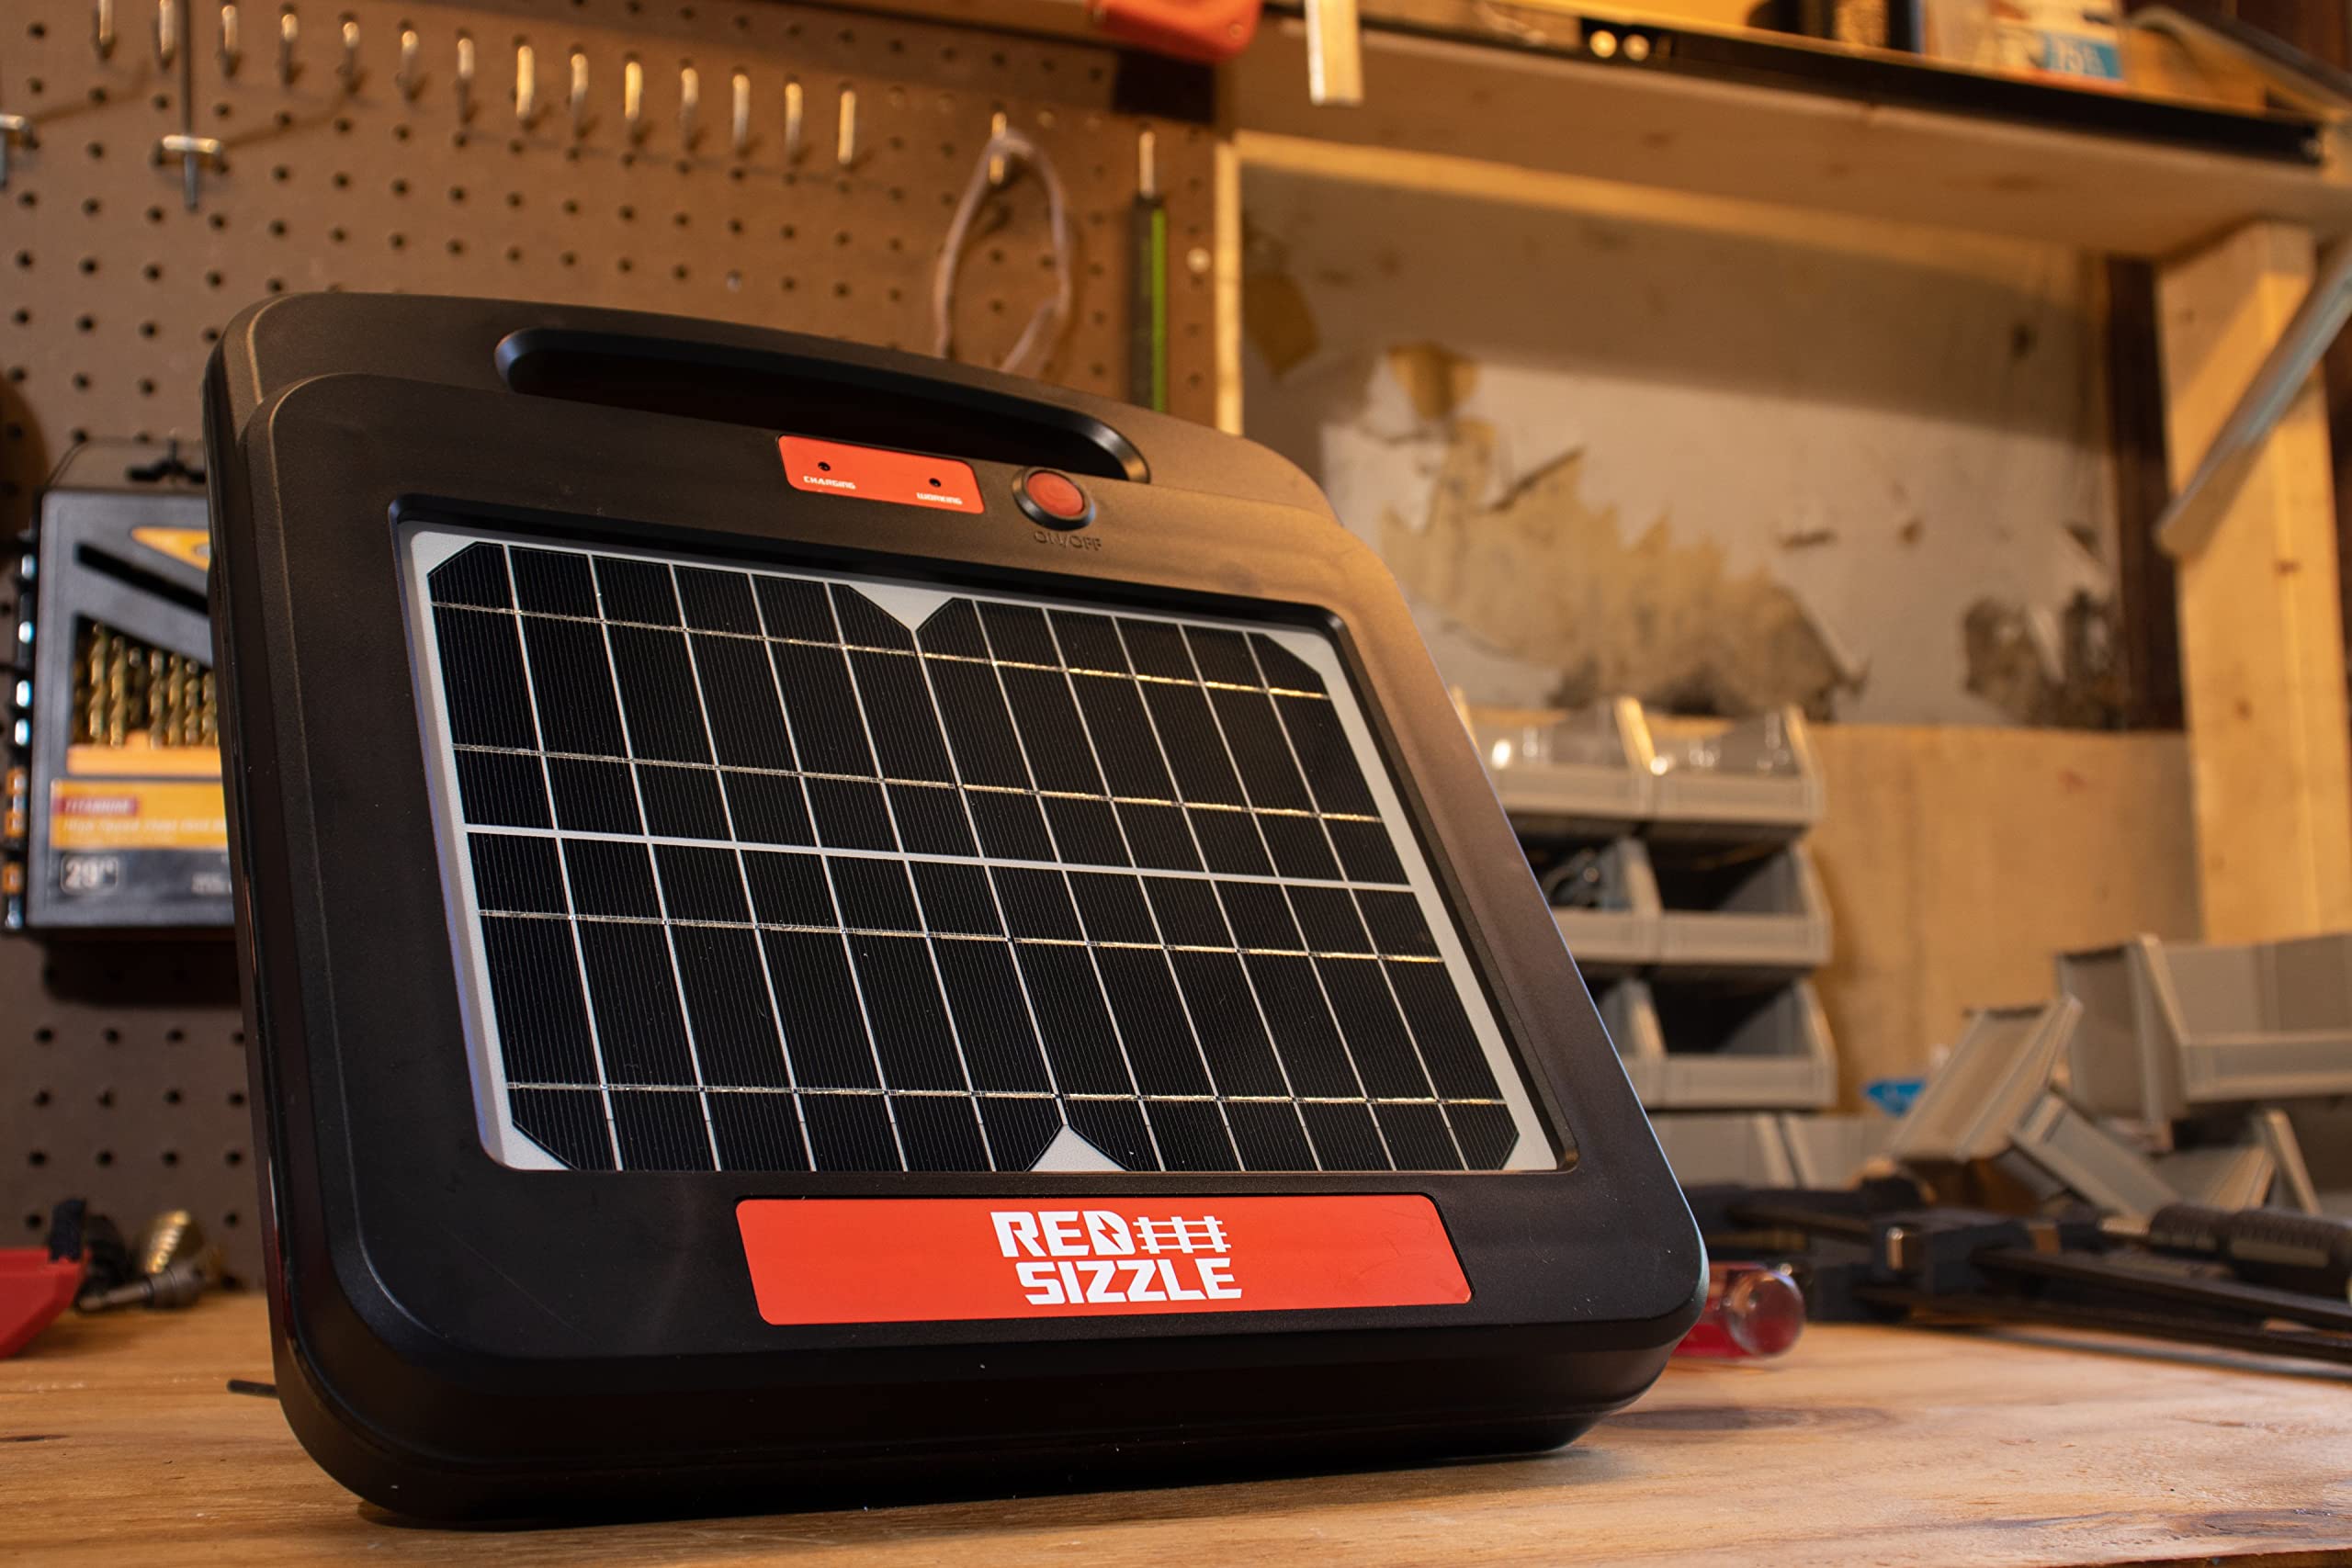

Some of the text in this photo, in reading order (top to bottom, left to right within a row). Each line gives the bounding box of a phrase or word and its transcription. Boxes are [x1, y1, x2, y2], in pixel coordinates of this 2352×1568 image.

[803, 475, 963, 505] CHARGING WORKING
[1034, 530, 1102, 551] ON/OFF
[990, 1211, 1136, 1257] RED
[1015, 1258, 1242, 1305] SIZZLE
